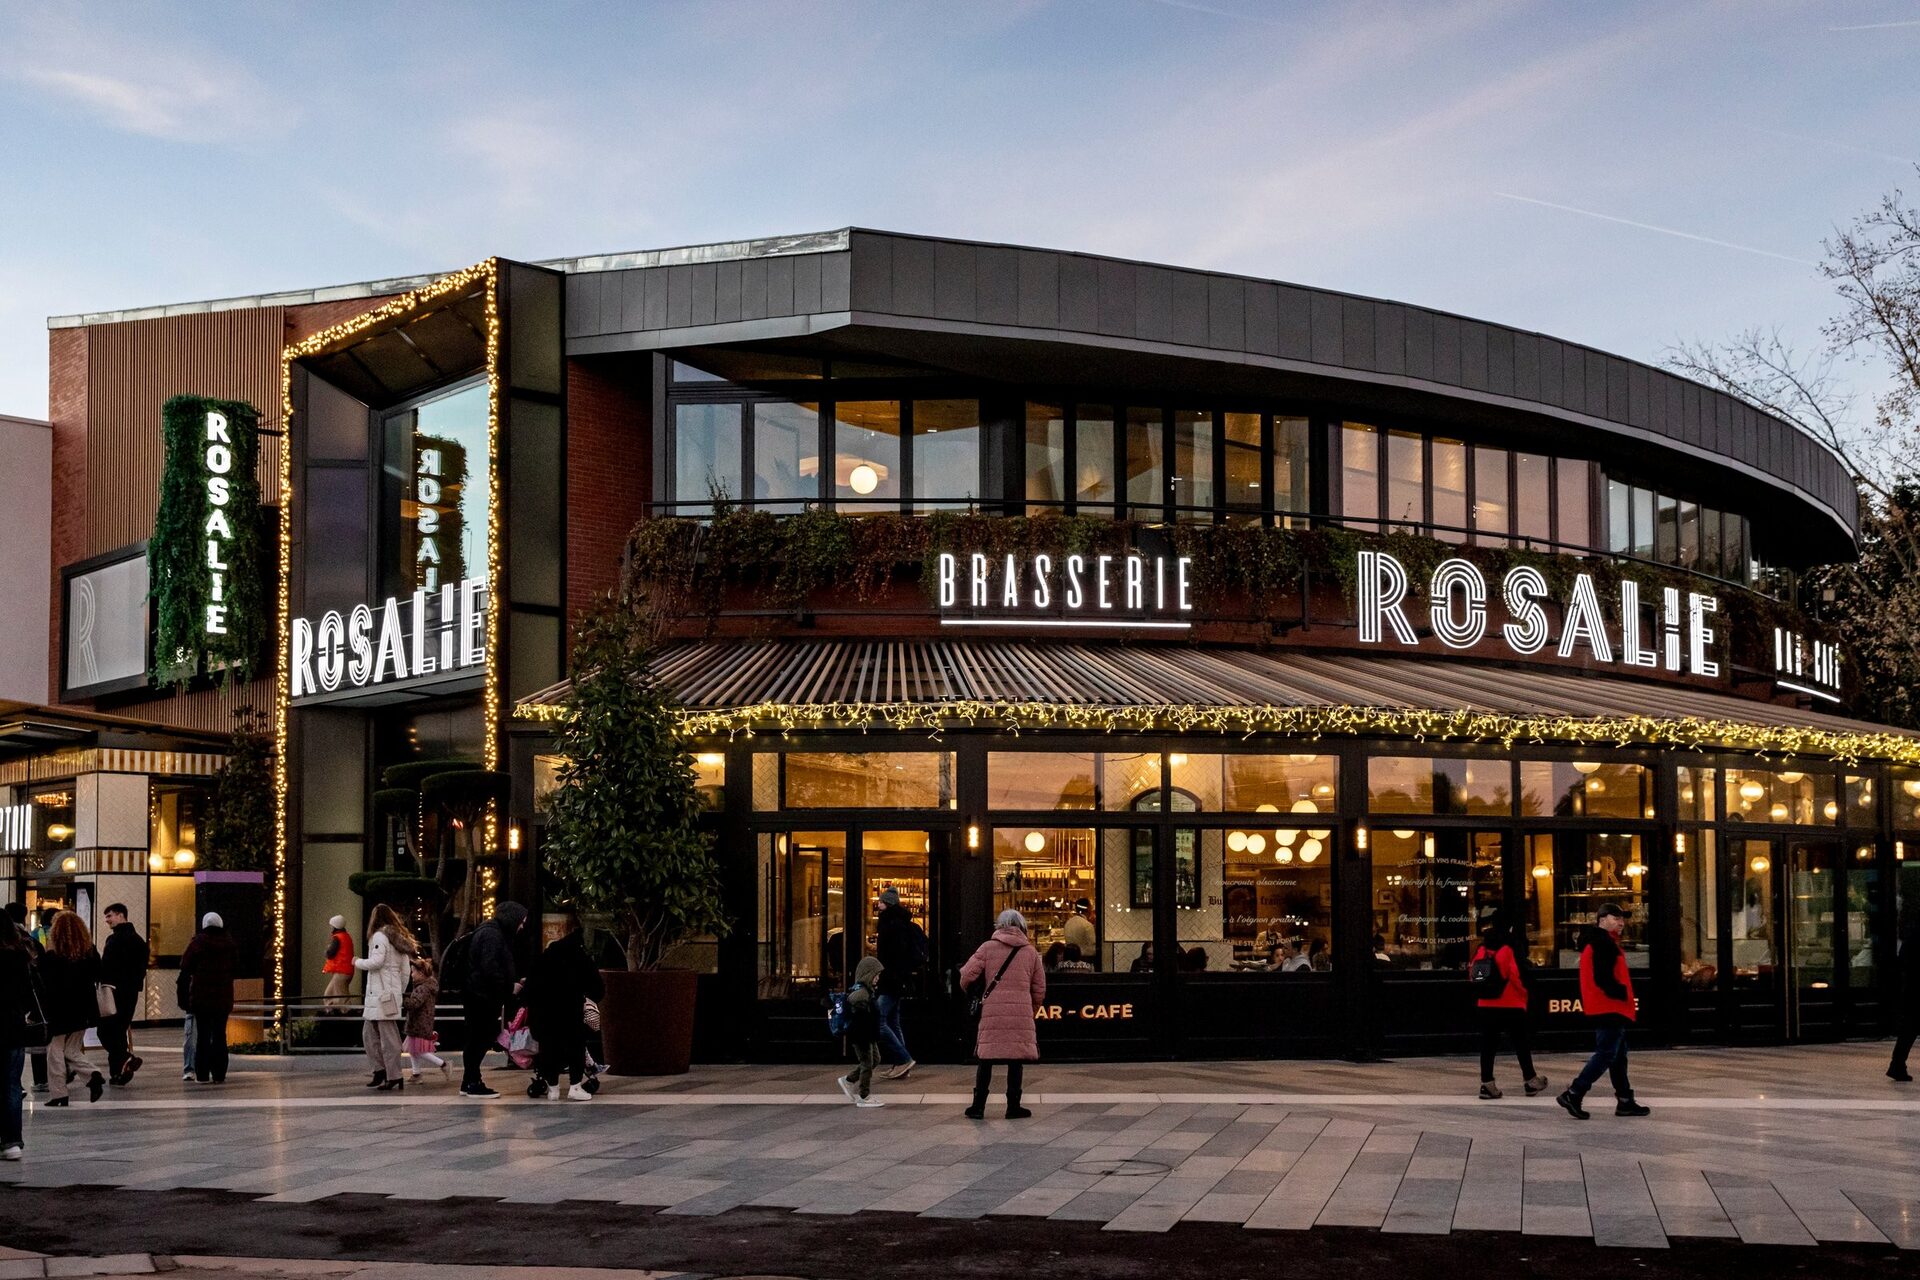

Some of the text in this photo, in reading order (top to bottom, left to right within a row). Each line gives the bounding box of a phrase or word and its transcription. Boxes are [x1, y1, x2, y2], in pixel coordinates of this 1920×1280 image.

[206, 412, 230, 634] ROSALIE
[939, 552, 1194, 610] BRASSERIE
[1357, 550, 1720, 677] ROSALIE
[291, 576, 486, 696] ROSALIE
[1256, 876, 1297, 886] alsacienne
[1229, 915, 1235, 924] à
[1237, 914, 1268, 926] l'oignon
[1398, 913, 1438, 925] Champagne
[1035, 1006, 1062, 1019] AR
[1082, 1003, 1133, 1019] CAFÉ
